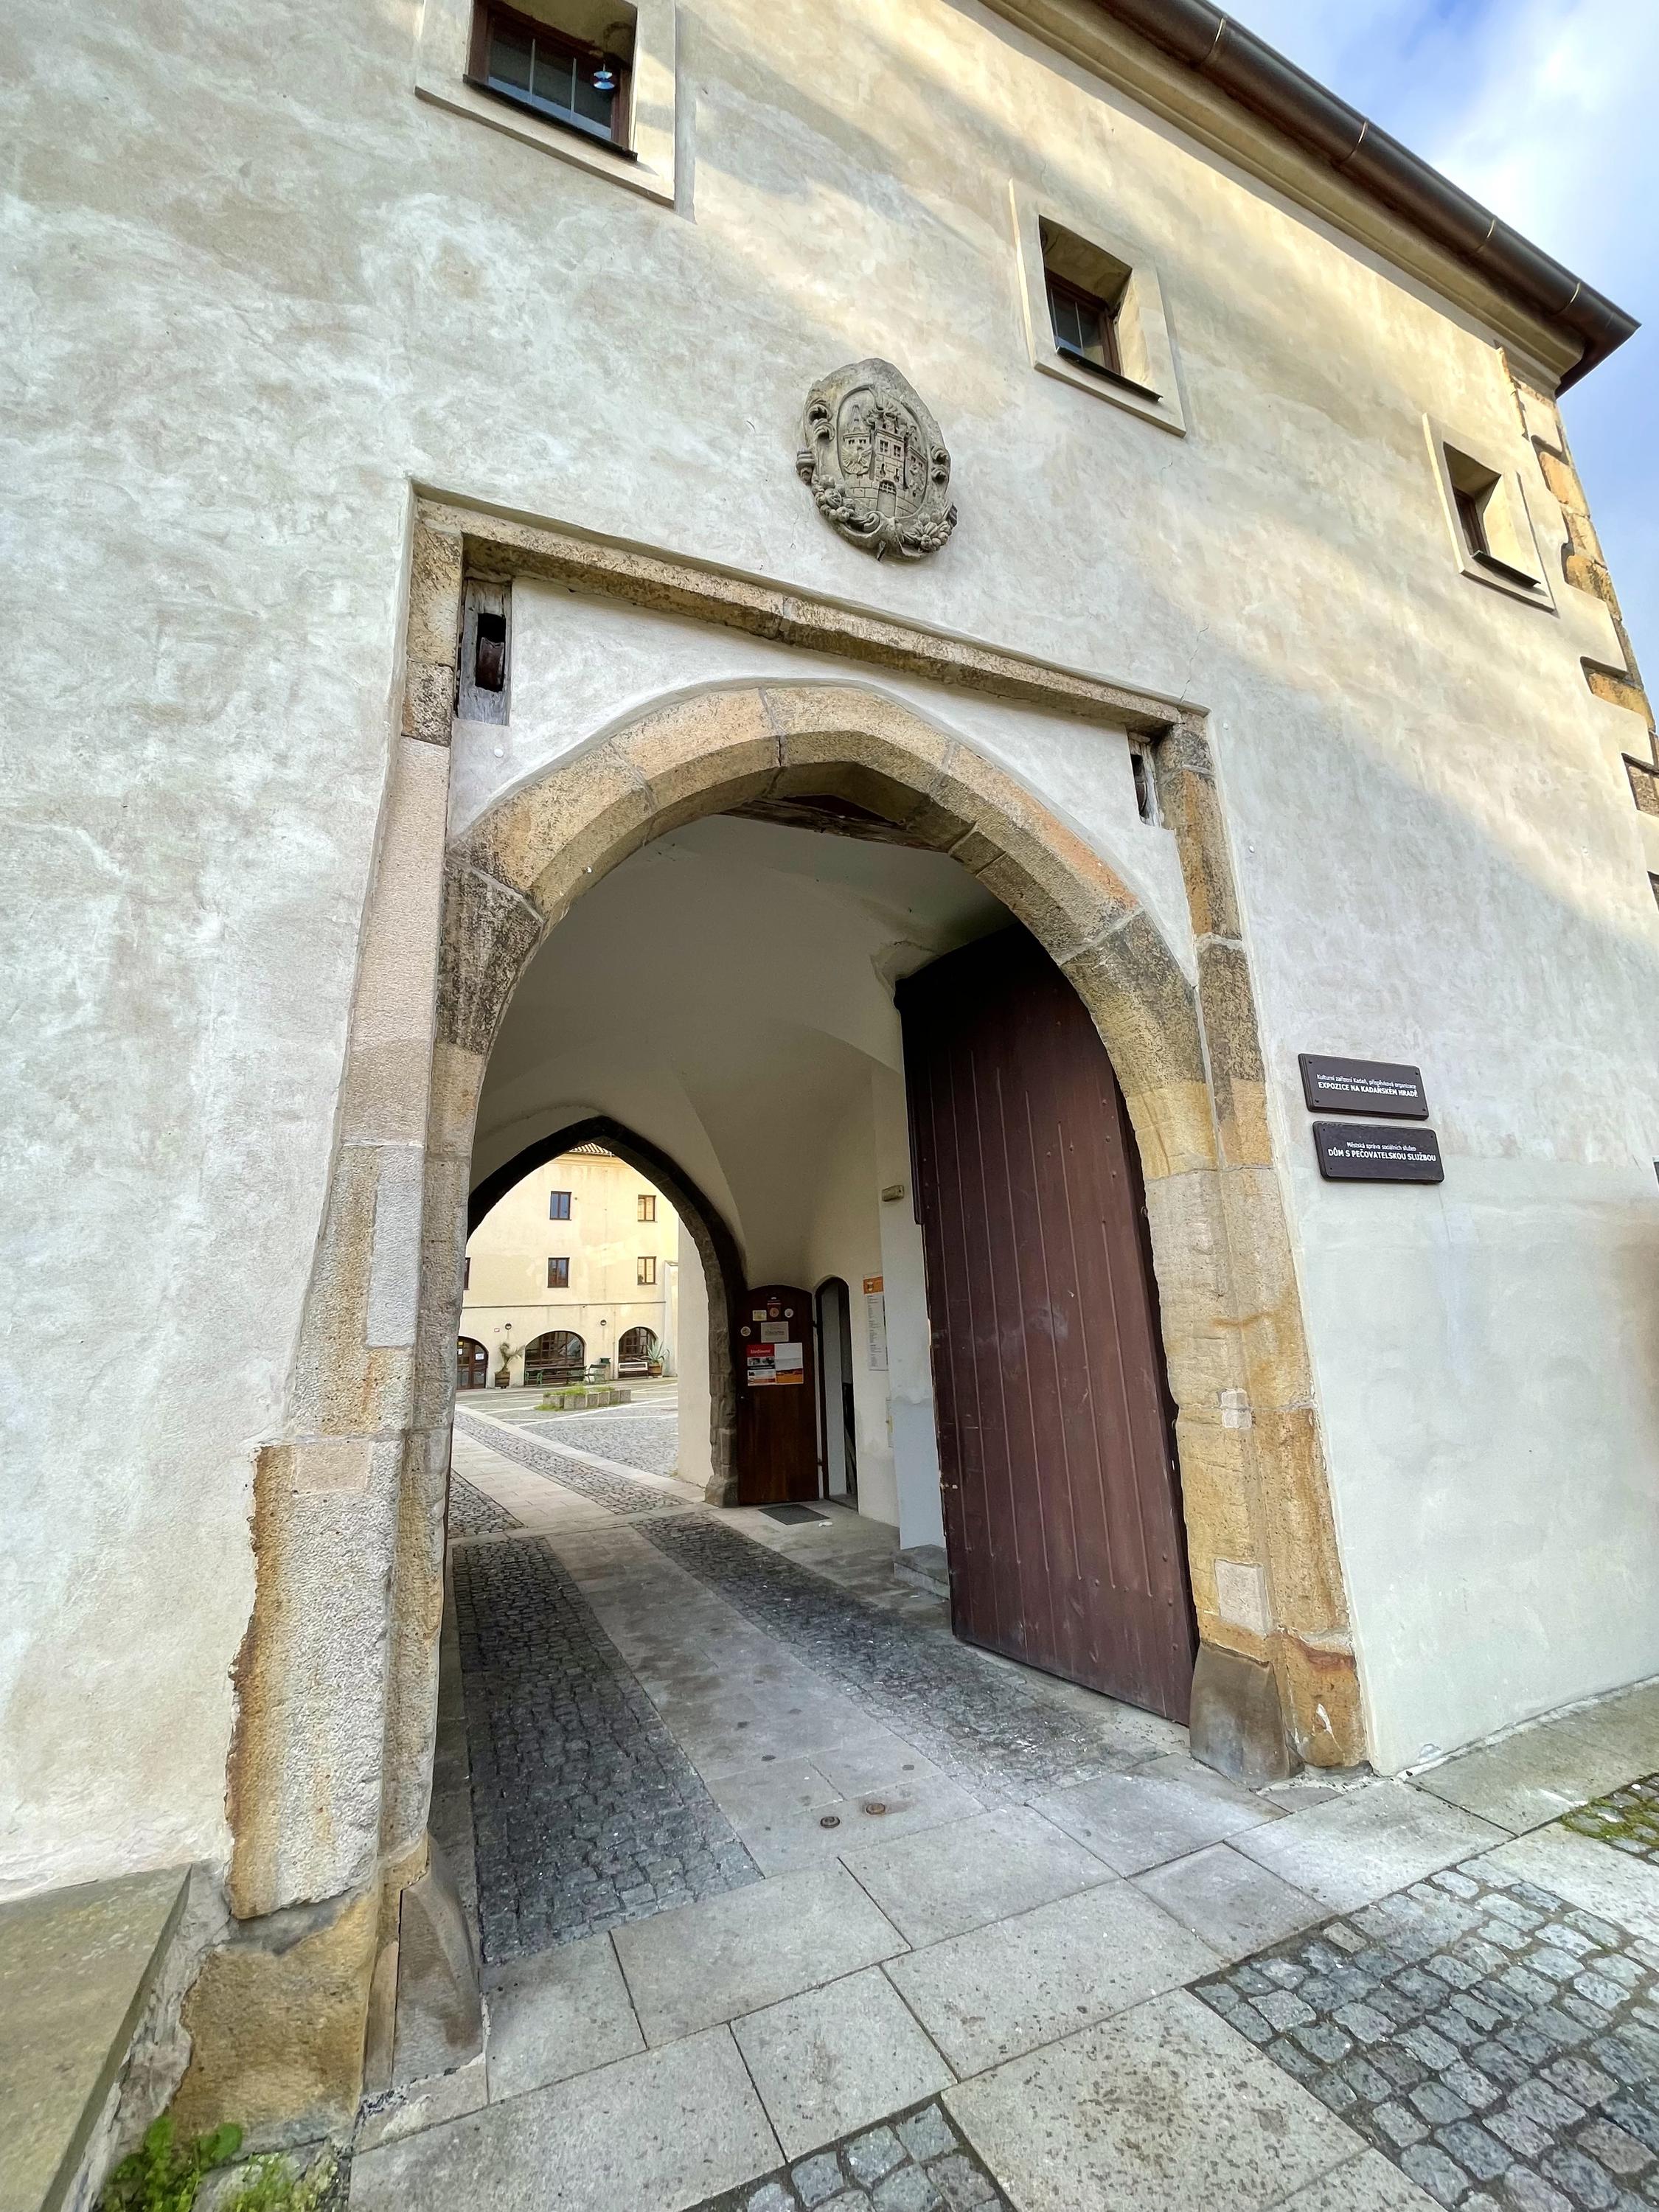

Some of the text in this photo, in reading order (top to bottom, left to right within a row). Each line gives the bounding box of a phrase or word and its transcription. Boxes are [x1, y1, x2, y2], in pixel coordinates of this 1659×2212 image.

[1318, 1081, 1349, 1091] EXPOZICE
[1398, 1089, 1419, 1097] HRADĚ
[1327, 1147, 1436, 1161] DŮM S PEČOVATELSKOU SLUŽBOU
